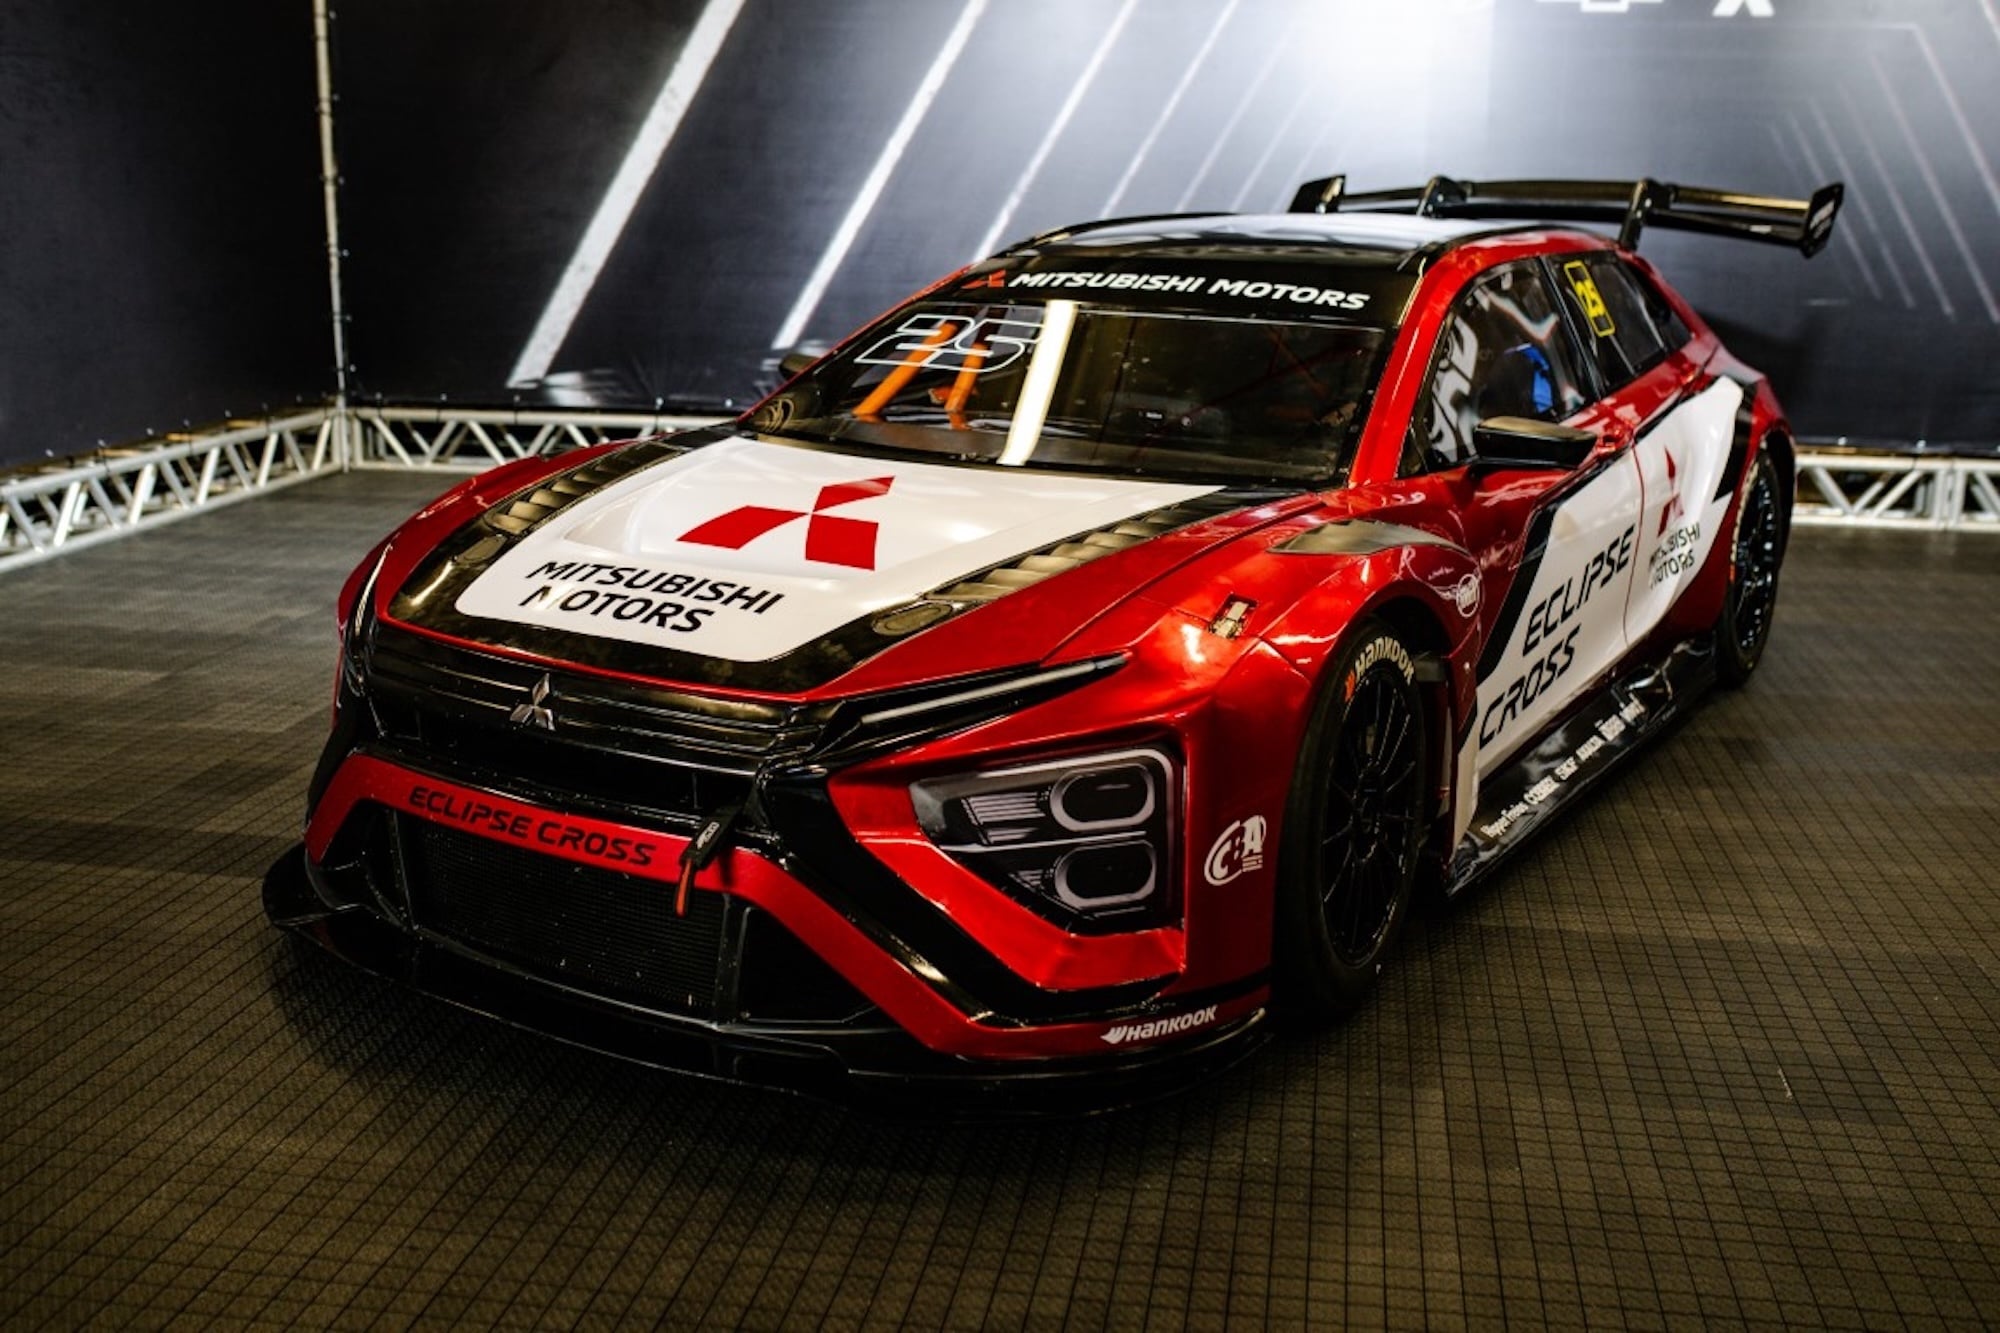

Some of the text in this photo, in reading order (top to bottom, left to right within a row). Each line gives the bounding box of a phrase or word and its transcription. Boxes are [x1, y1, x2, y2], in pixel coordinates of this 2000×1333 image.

[1008, 270, 1370, 311] MITSUBISHI MOTORS
[853, 313, 1044, 373] 25
[525, 561, 785, 615] MITSUBISHI
[1522, 524, 1637, 657] ECLIPSE
[1478, 625, 1581, 751] CROSS
[409, 785, 533, 839] ECLIPSE
[536, 820, 658, 867] CROSS
